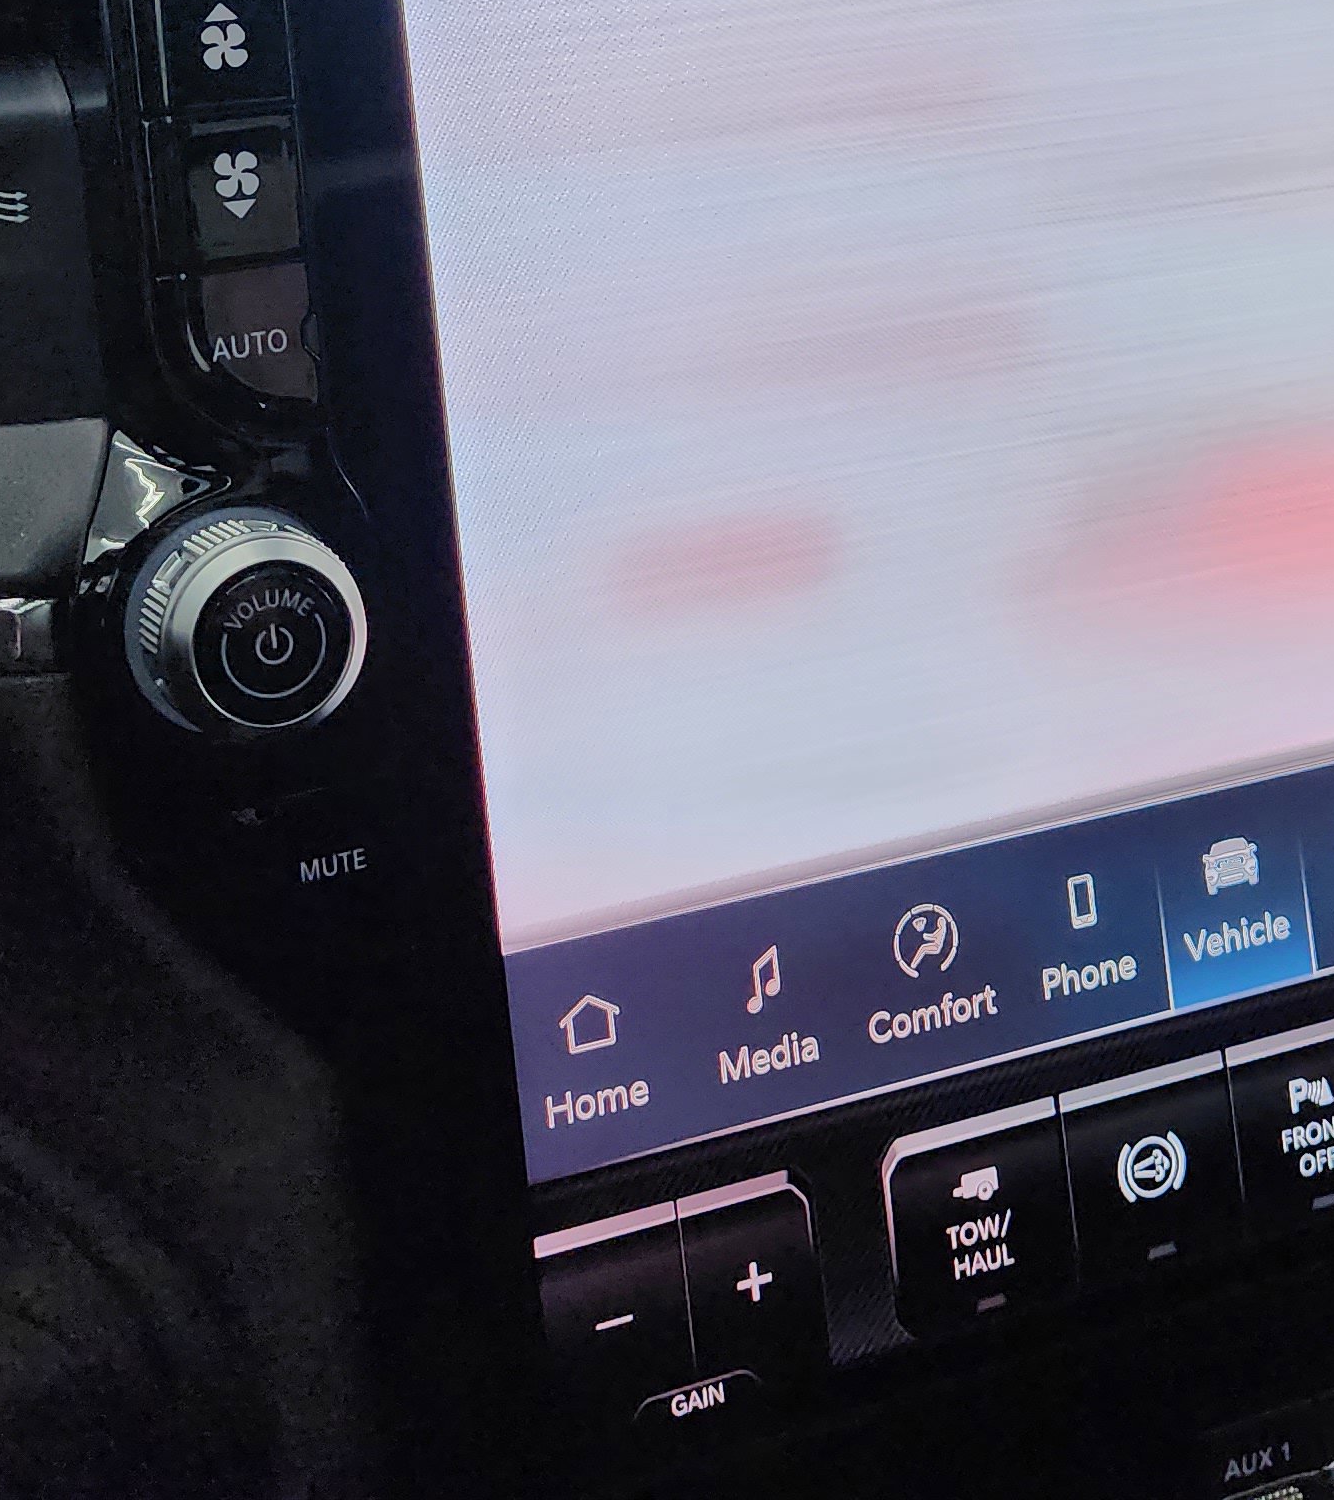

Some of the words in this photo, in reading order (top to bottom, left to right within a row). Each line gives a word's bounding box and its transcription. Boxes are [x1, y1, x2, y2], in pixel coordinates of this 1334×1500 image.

[211, 328, 289, 364] AUTO
[222, 587, 316, 632] VOLUME
[299, 847, 368, 884] MUTE
[1183, 911, 1292, 963] Vehicle
[1042, 954, 1138, 1002] Phone
[868, 984, 999, 1045] Comfort
[717, 1030, 821, 1085] Media
[543, 1079, 650, 1130] Home
[945, 1208, 1013, 1251] TOW/
[953, 1243, 1016, 1280] HAUL
[670, 1381, 727, 1418] GAIN
